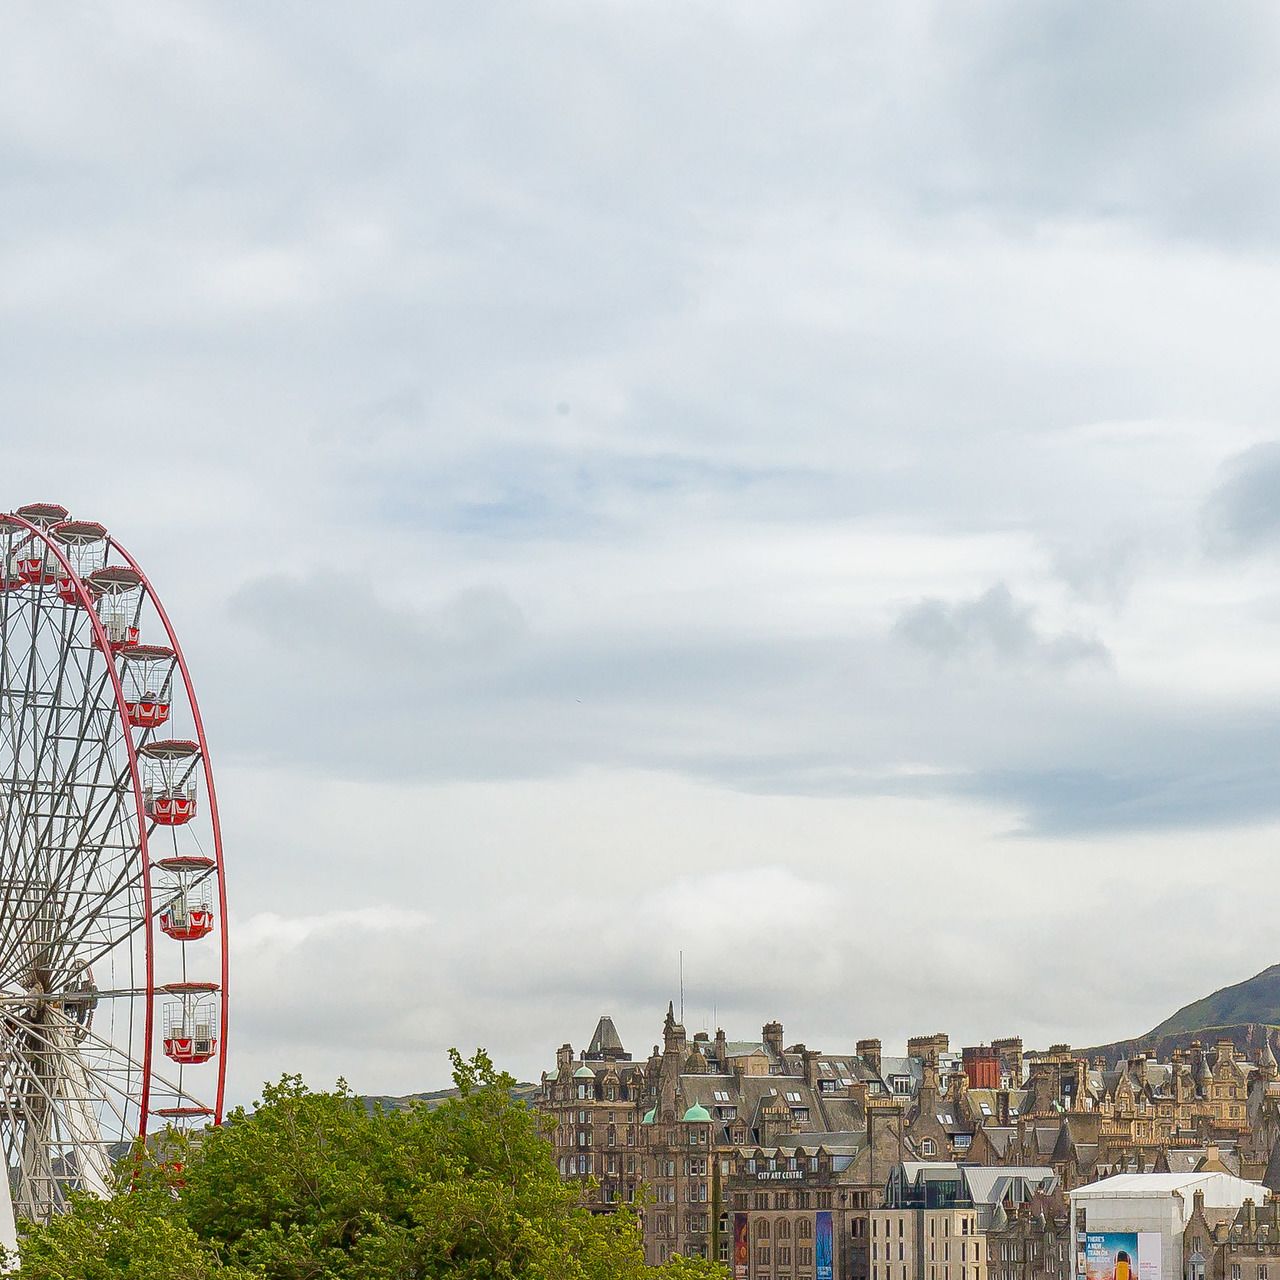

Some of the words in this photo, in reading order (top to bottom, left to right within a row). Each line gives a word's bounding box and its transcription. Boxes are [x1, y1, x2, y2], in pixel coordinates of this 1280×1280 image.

[757, 1171, 770, 1180] CITY
[770, 1171, 781, 1180] ART
[782, 1170, 803, 1179] CENTRE
